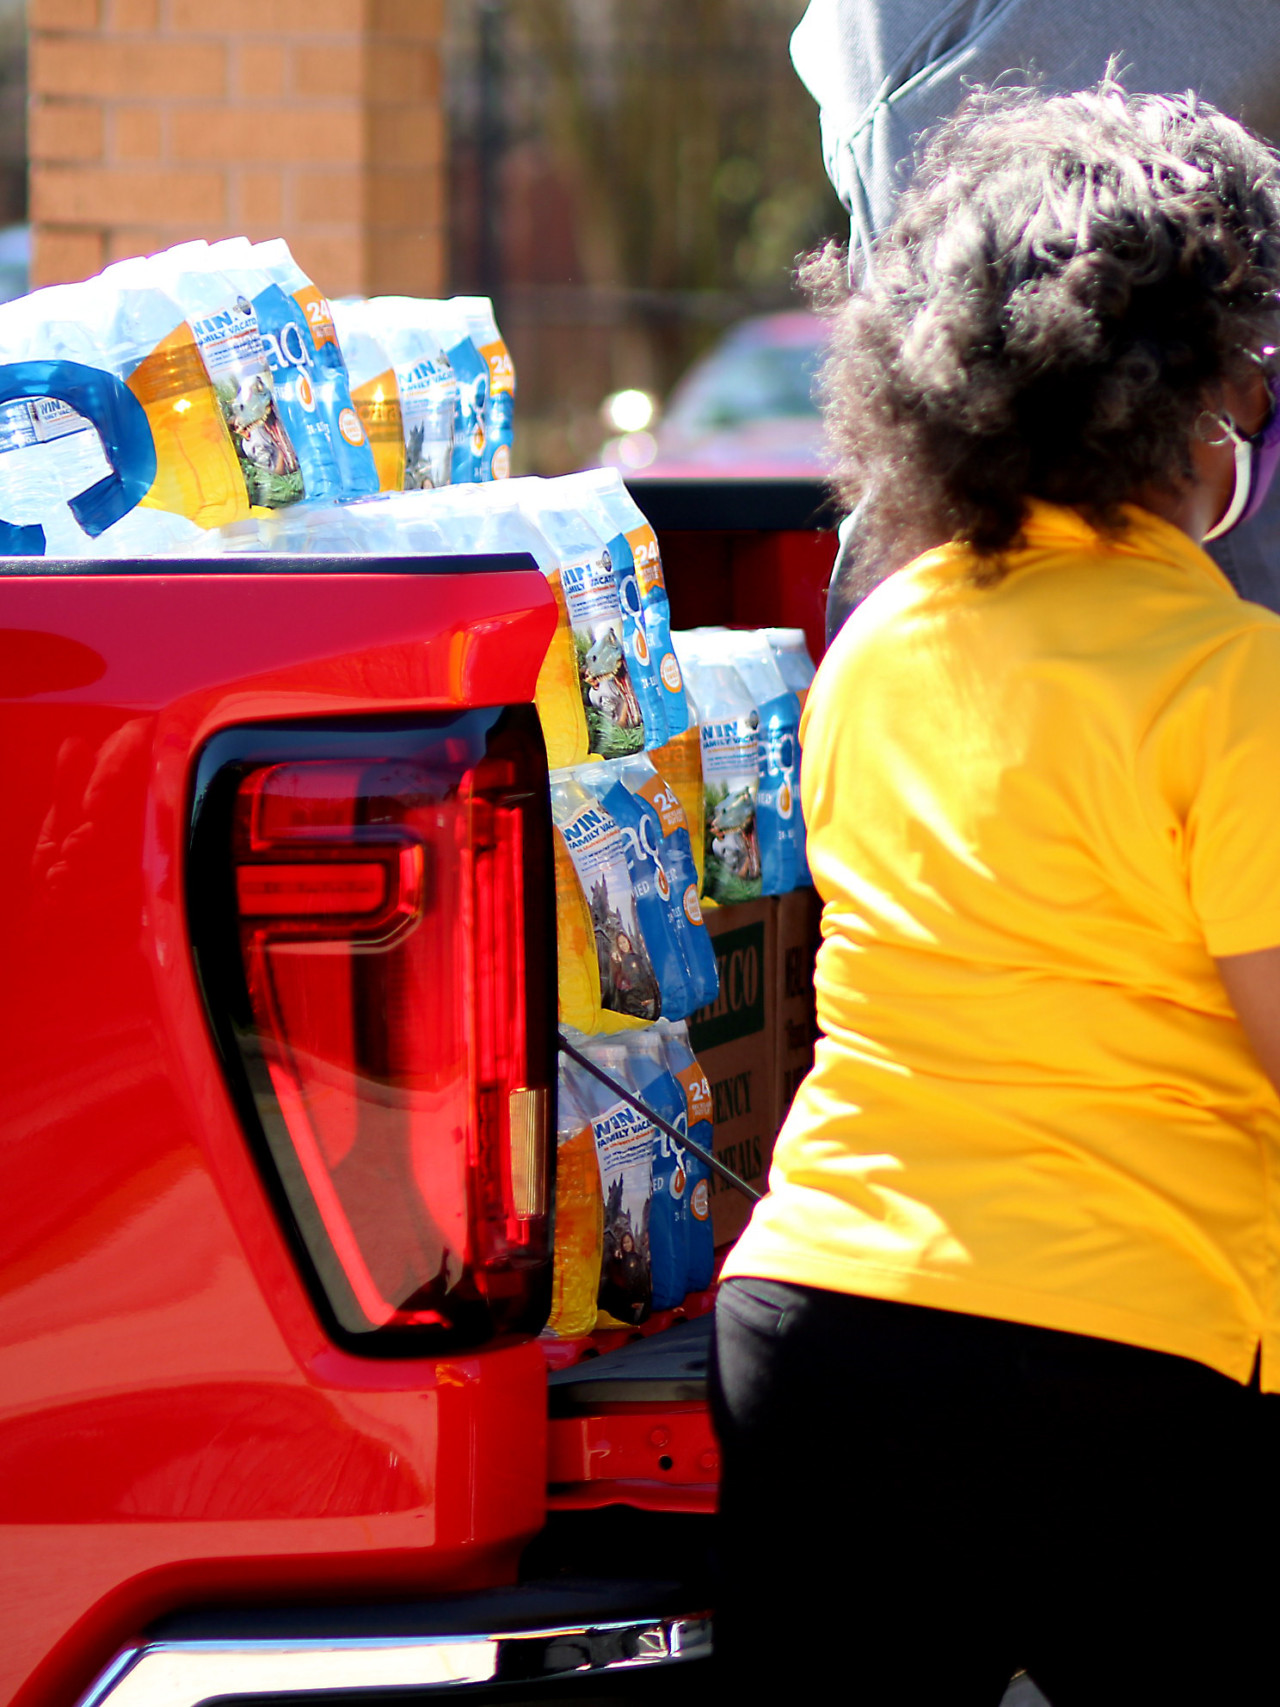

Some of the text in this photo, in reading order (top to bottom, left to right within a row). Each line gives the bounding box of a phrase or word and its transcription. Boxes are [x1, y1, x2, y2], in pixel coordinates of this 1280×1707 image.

[306, 302, 331, 323] 24
[635, 541, 658, 565] 24
[654, 788, 679, 812] 24
[564, 809, 602, 841] WIN
[689, 1078, 710, 1102] 24
[594, 1107, 634, 1140] WIN
